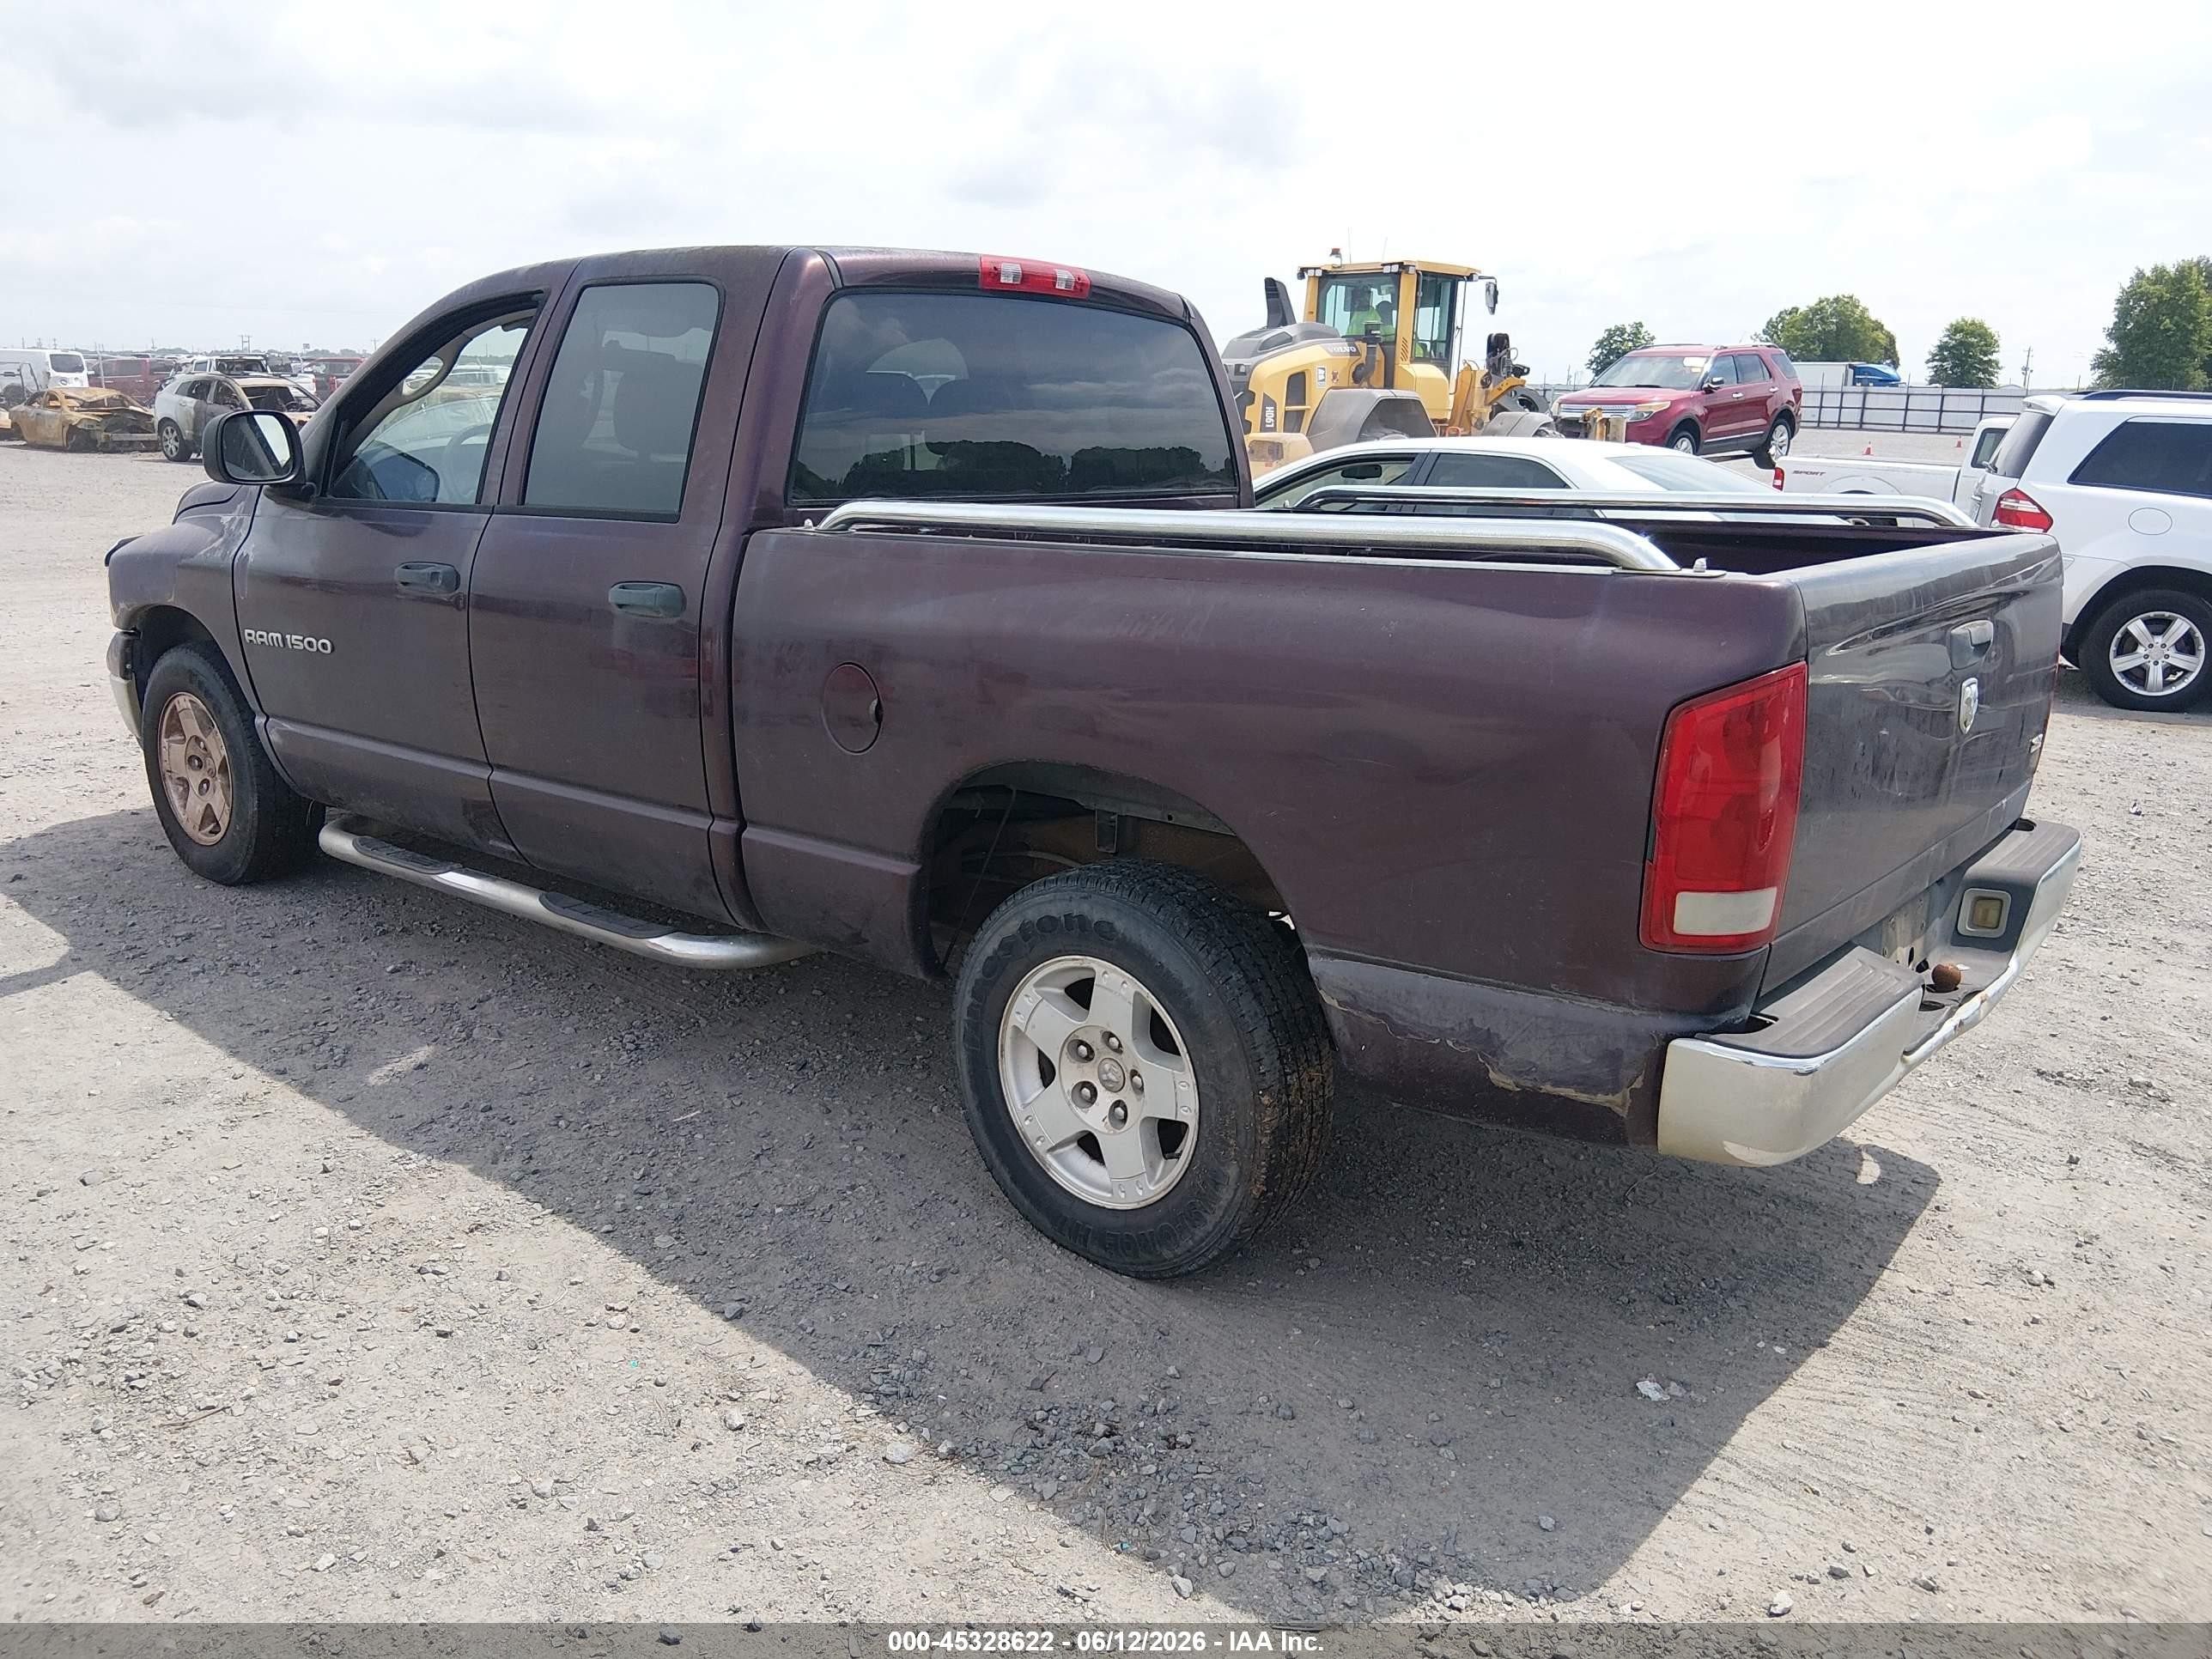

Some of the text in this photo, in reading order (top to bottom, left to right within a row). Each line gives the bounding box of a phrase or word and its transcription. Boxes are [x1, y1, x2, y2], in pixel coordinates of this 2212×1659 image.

[1265, 405, 1275, 428] L90H
[244, 629, 331, 654] RAM 1500
